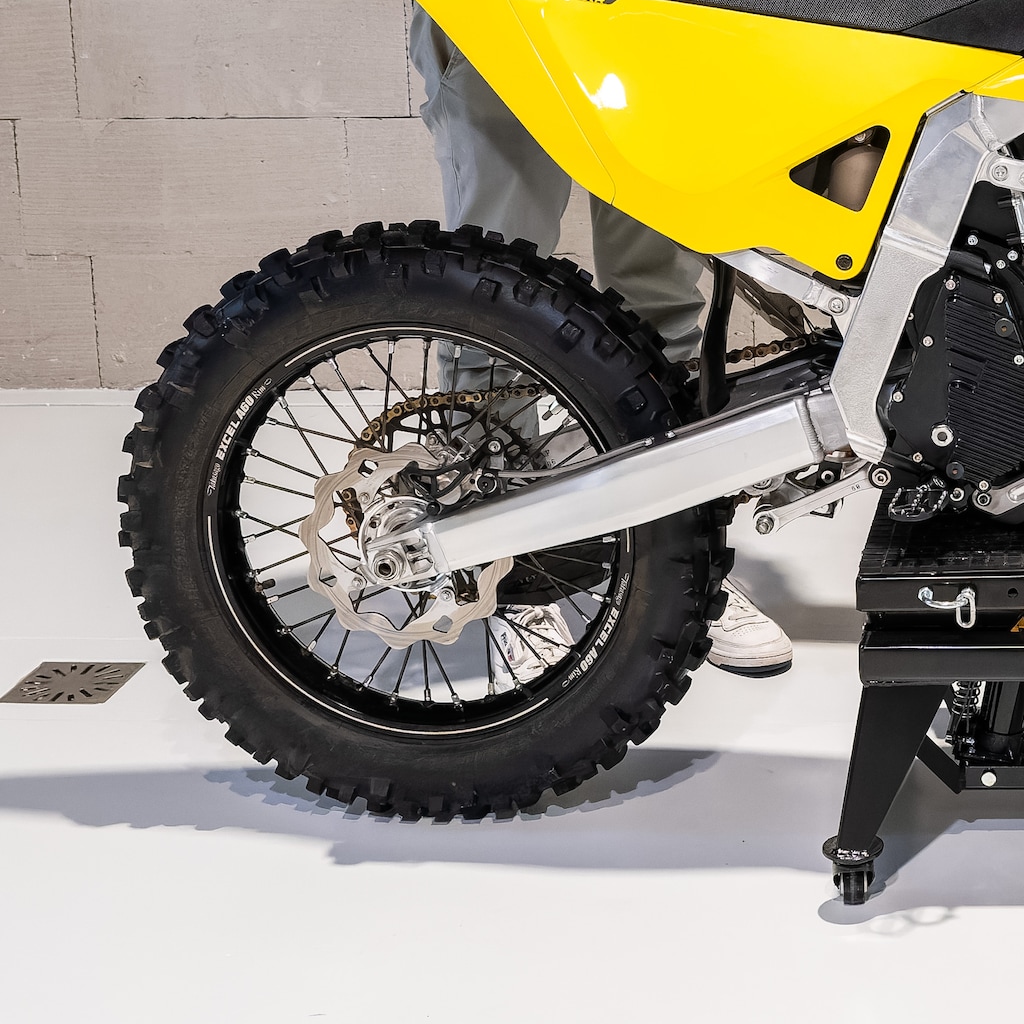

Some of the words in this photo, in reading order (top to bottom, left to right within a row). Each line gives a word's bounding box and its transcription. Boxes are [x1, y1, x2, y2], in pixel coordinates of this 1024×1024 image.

[215, 419, 241, 461] EXCEL
[236, 394, 255, 421] A60
[251, 385, 266, 400] Rim
[595, 606, 620, 647] EXCEL
[579, 646, 599, 672] A60
